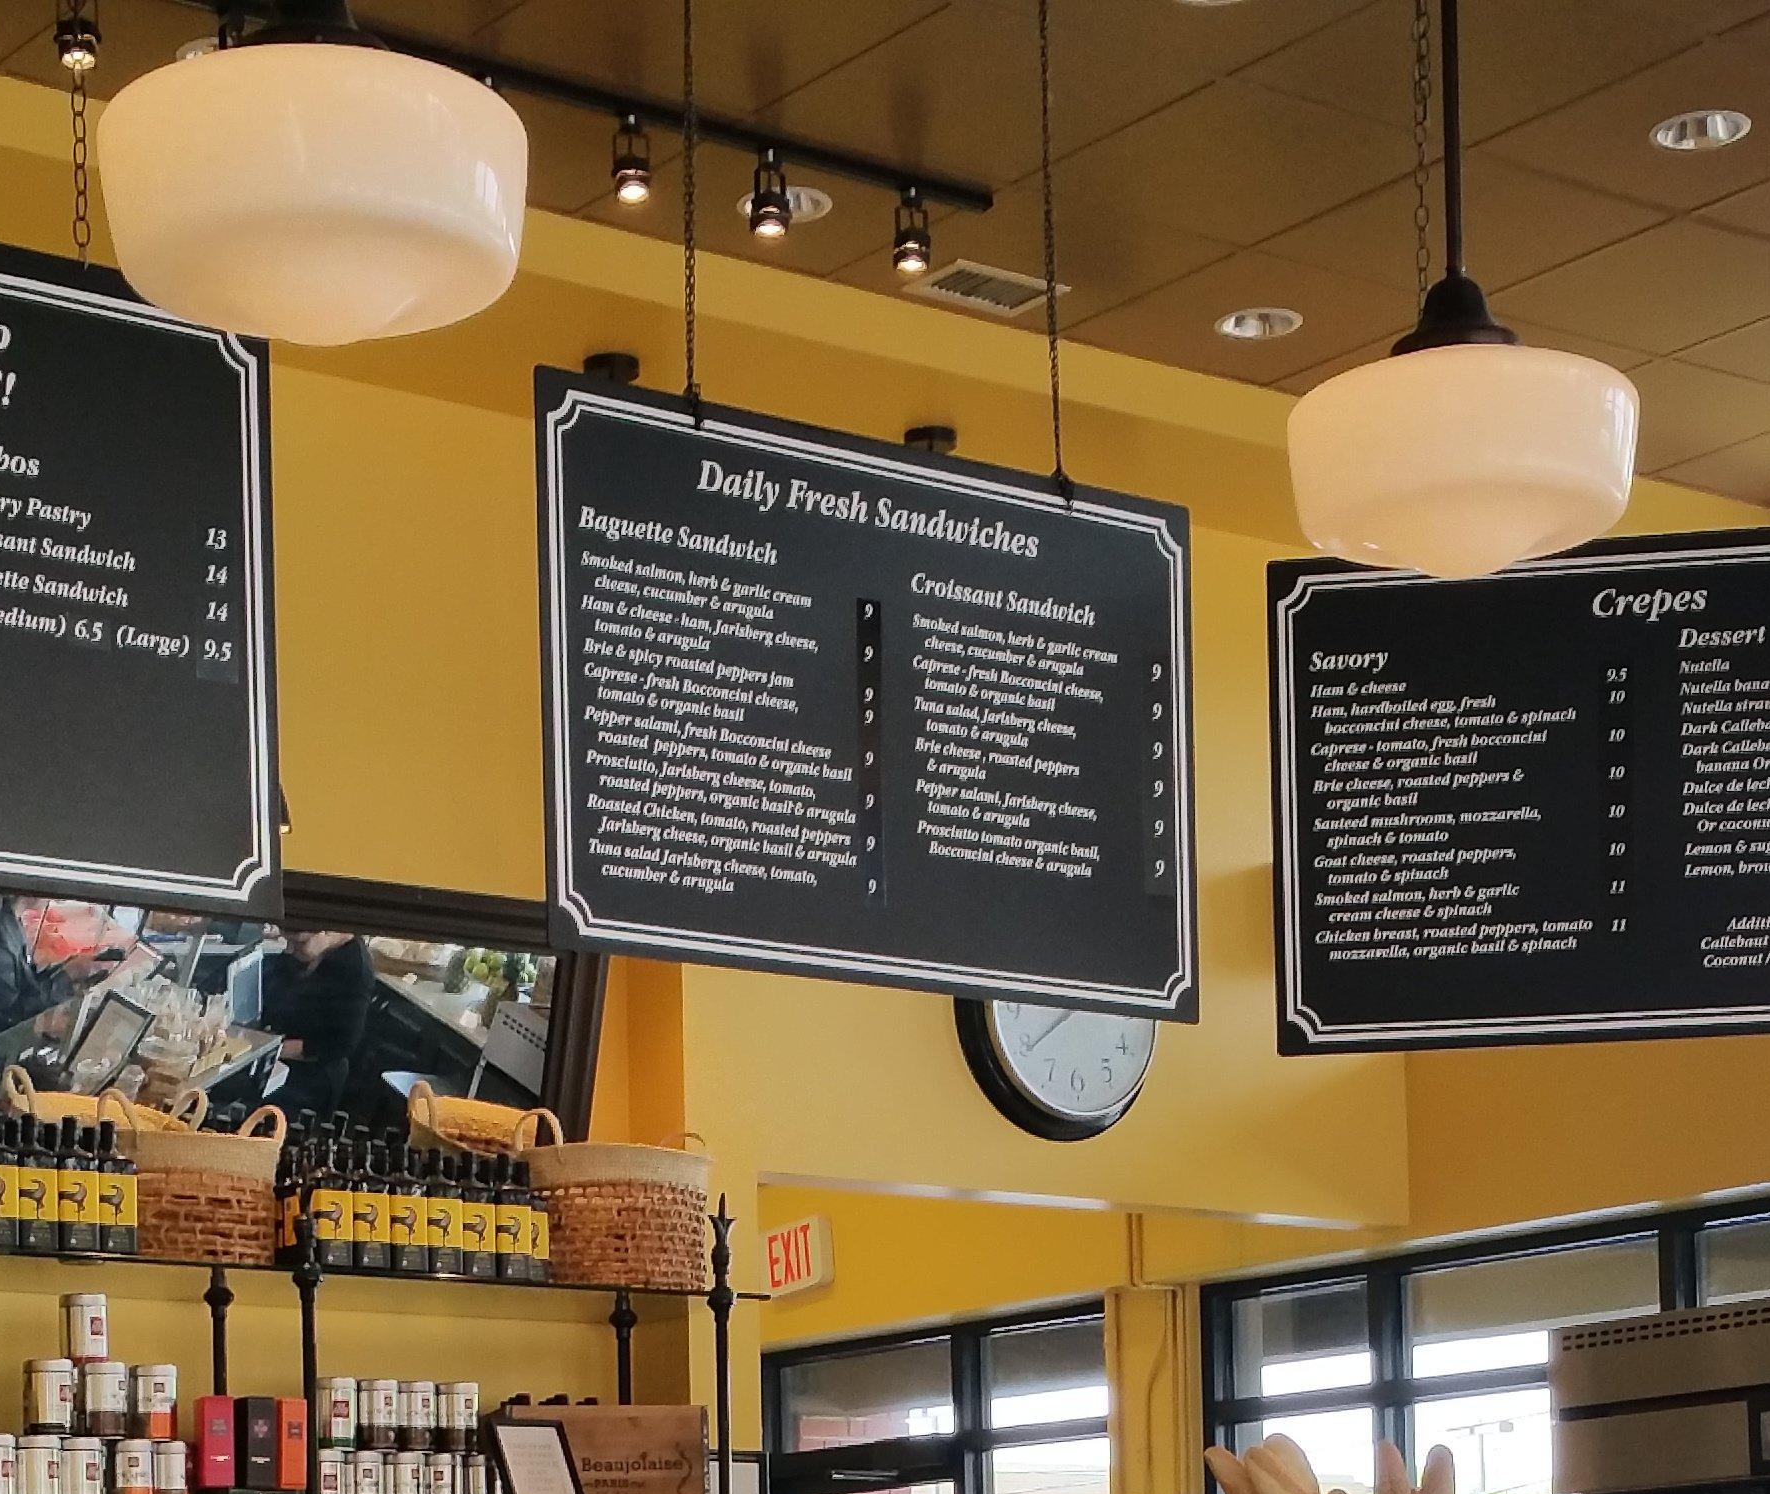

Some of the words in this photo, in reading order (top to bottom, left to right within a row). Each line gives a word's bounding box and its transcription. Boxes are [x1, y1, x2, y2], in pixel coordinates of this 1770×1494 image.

[26, 497, 92, 530] Pastry
[206, 527, 227, 550] 13
[696, 459, 780, 512] Daily
[786, 478, 869, 524] Fresh
[874, 497, 1040, 558] Sandwiches
[578, 505, 674, 544] Baguette
[676, 526, 778, 566] Sandwich
[910, 572, 1004, 610] Croissant
[1005, 590, 1096, 628] Sandwich
[1592, 588, 1708, 623] Crepes
[74, 618, 104, 642] 6.5
[116, 624, 190, 658] (Large)
[203, 638, 232, 662] 9.5
[1678, 625, 1766, 648] Dessert
[583, 637, 614, 656] Brie
[615, 643, 628, 658] &
[628, 648, 664, 669] spicy
[665, 655, 715, 675] roasted
[715, 662, 768, 684] peppers
[767, 671, 794, 688] jam
[864, 687, 874, 702] 9
[1308, 651, 1389, 674] Savory
[1310, 684, 1344, 698] Ham
[1346, 682, 1359, 696] &
[1360, 681, 1407, 694] cheese
[1606, 667, 1628, 682] 9.5
[1679, 658, 1730, 674] Nutella
[767, 1222, 813, 1290] EXIT
